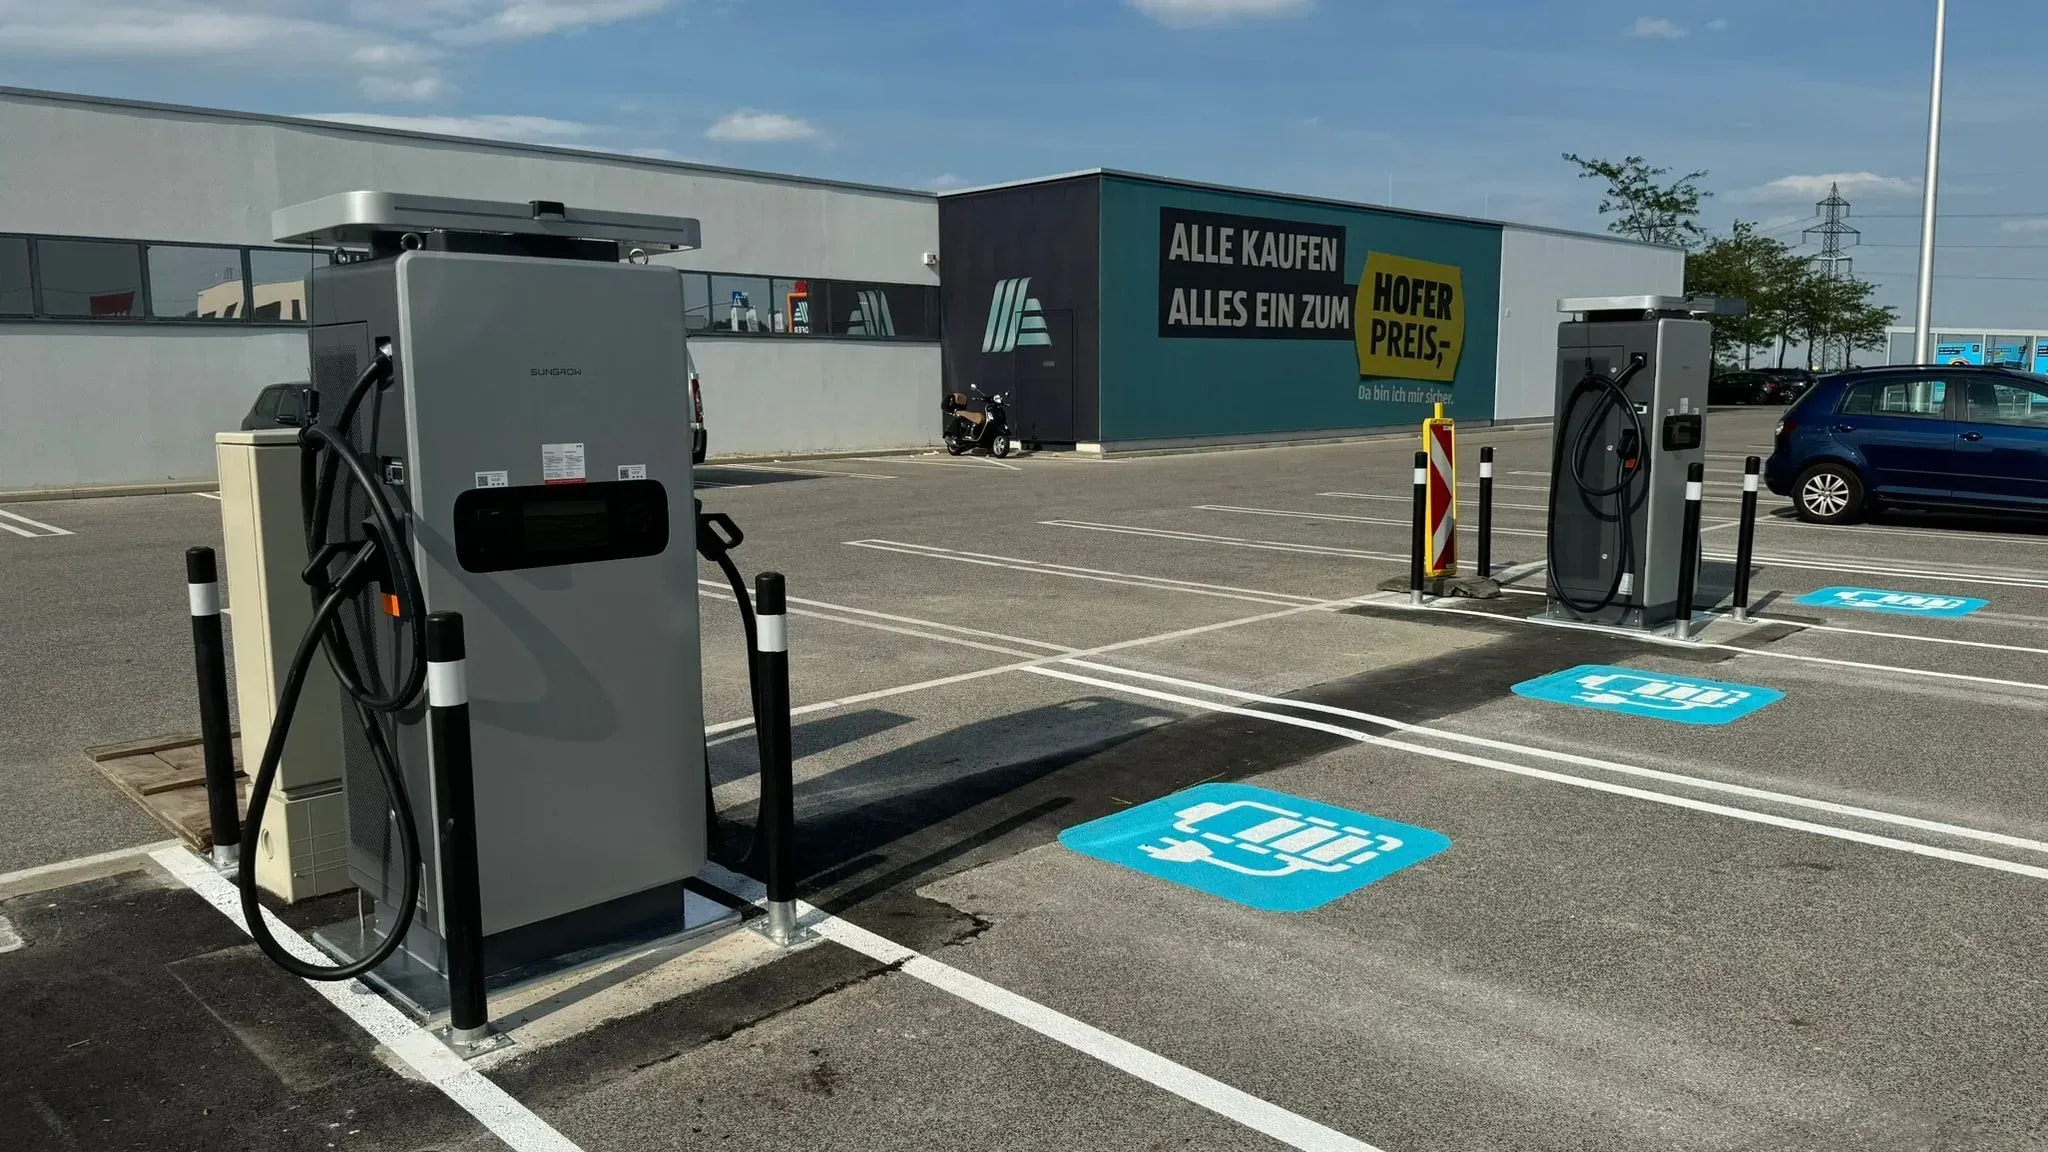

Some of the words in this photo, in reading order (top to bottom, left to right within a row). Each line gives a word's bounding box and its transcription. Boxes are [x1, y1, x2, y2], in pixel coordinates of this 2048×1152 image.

[1168, 222, 1234, 265] ALLE
[1242, 229, 1338, 272] KAUFEN
[1167, 287, 1249, 327] ALLES
[1255, 292, 1294, 328] EIN
[1300, 294, 1350, 329] ZUM
[1373, 272, 1453, 321] HOFER
[529, 368, 582, 376] SUNGROW
[1358, 384, 1371, 400] Da
[1373, 384, 1390, 402] bin
[1391, 385, 1406, 403] ich
[1407, 387, 1424, 404] mir
[1425, 388, 1454, 405] sicher.
